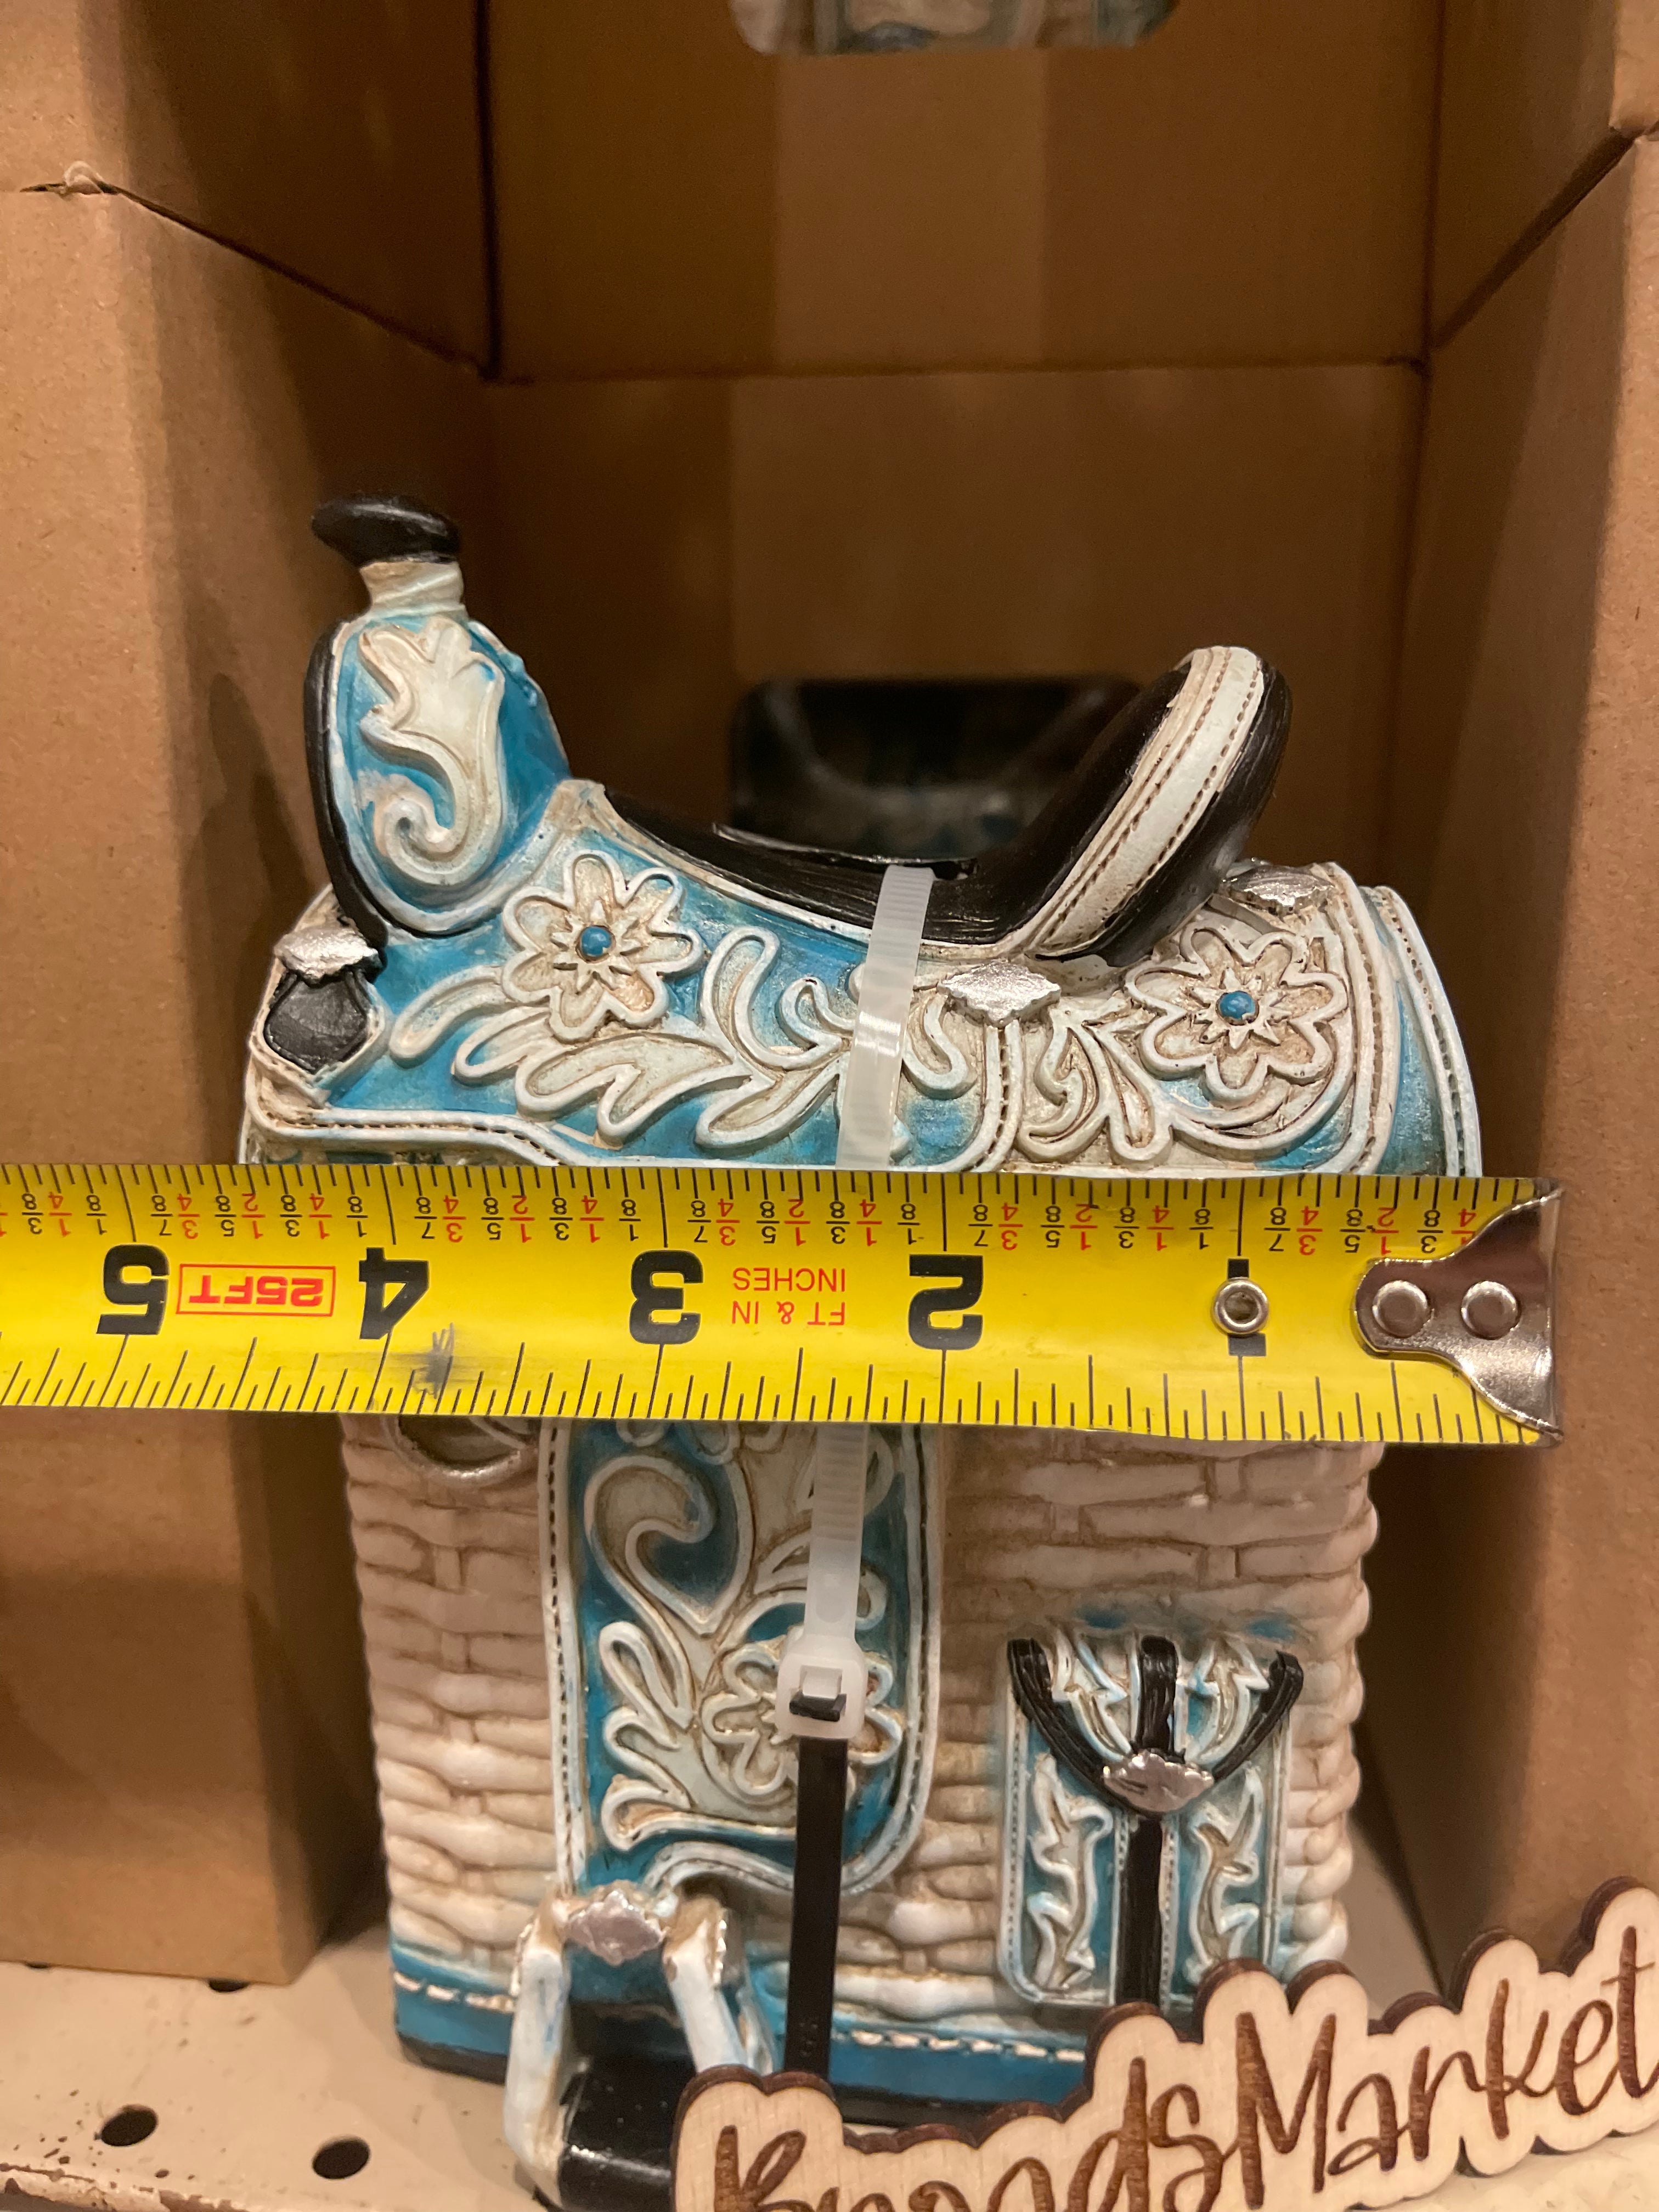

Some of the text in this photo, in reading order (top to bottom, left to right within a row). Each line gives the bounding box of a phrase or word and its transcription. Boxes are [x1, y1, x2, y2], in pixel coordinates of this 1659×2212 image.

[97, 1244, 170, 1335] 5
[189, 1274, 324, 1307] 25FT
[359, 1247, 429, 1340] 4
[629, 1250, 703, 1345] 3
[732, 1267, 846, 1292] INCHES
[732, 1300, 846, 1326] FT & IN
[909, 1254, 983, 1350] 2
